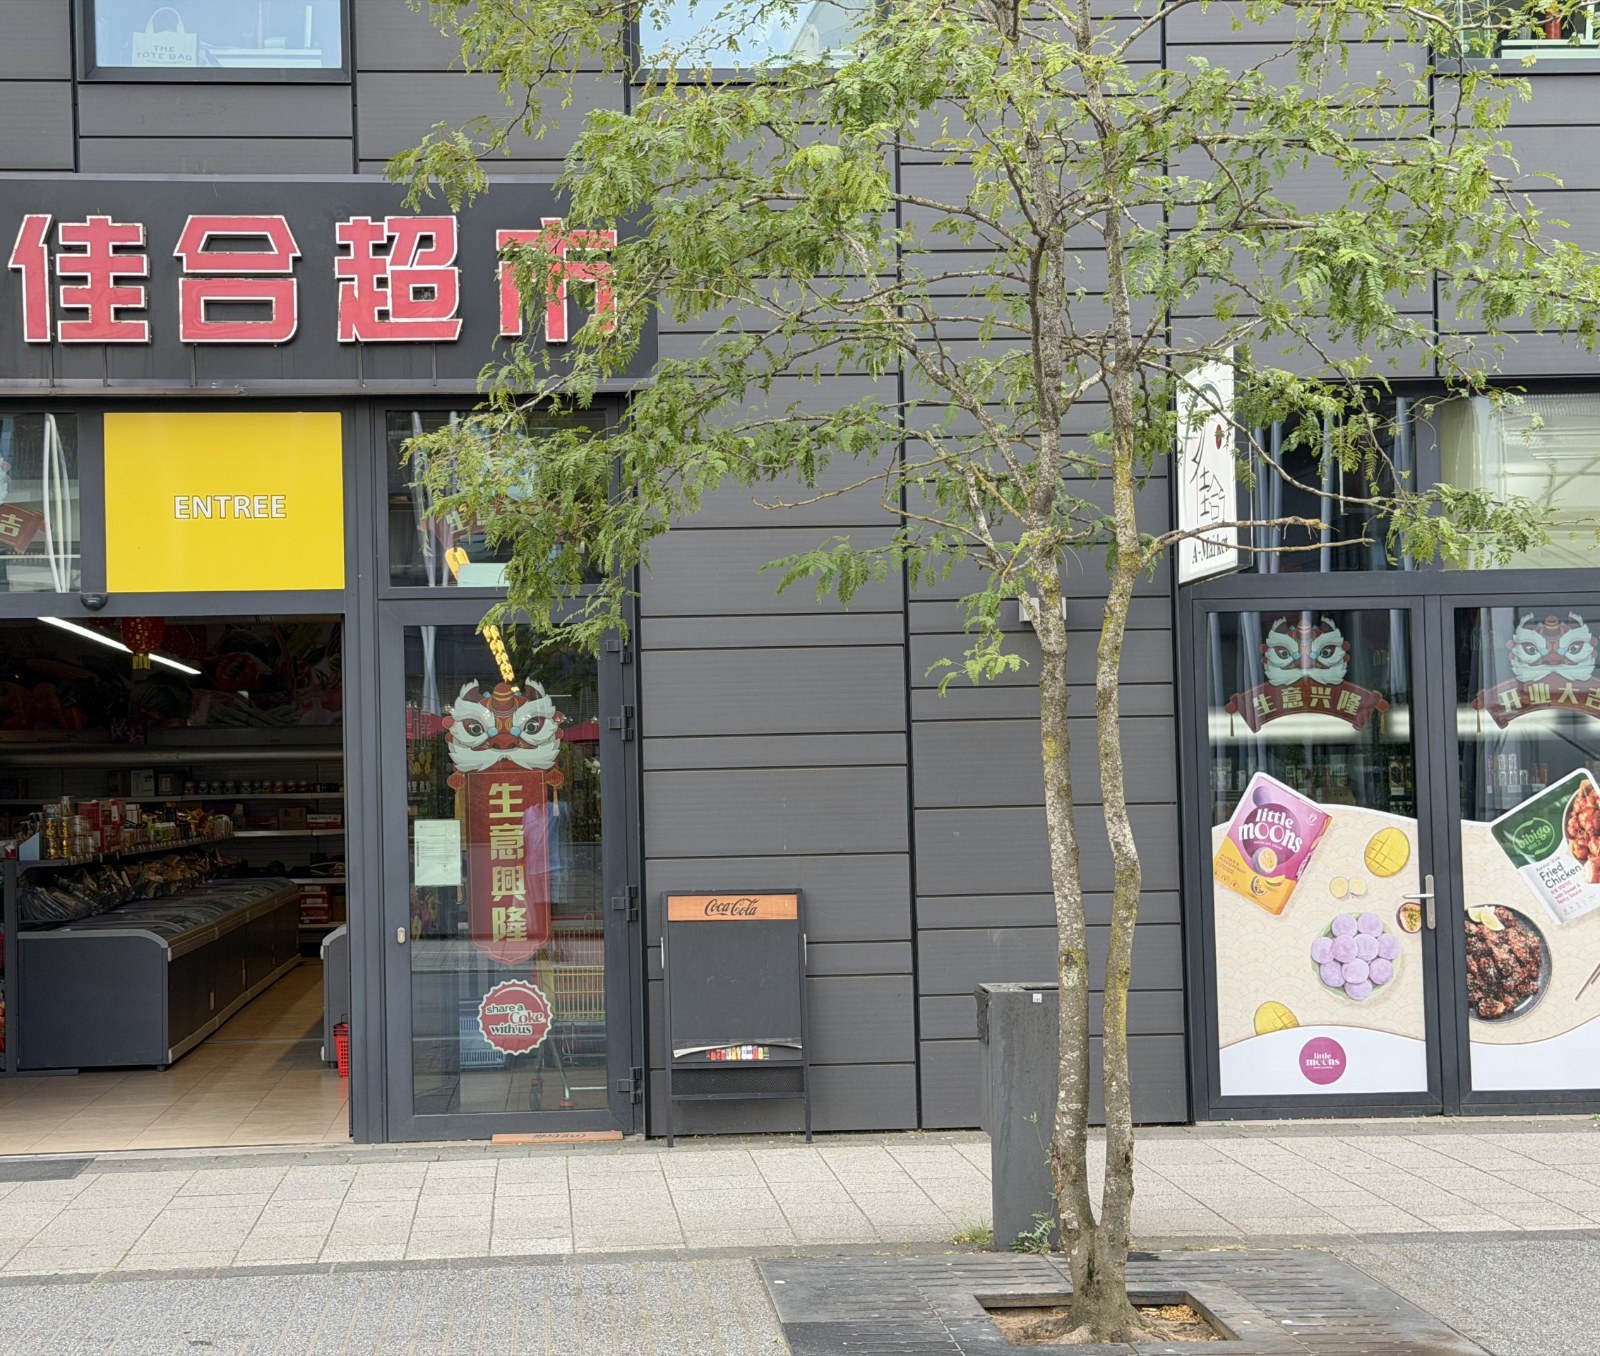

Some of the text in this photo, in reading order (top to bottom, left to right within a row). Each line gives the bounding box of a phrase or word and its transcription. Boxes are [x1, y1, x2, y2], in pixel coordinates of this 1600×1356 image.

[136, 52, 193, 61] TOTE BAG
[154, 45, 176, 53] THE
[8, 213, 617, 343] 佳合超市
[174, 495, 287, 519] ENTREE
[1252, 686, 1362, 717] 生意兴隆
[1255, 808, 1294, 829] little
[1517, 824, 1551, 849] bibigo
[489, 782, 528, 943] 生意興隆
[1539, 863, 1564, 881] Fried
[1545, 865, 1582, 889] Chicken
[704, 898, 760, 916] Coca-Cola
[486, 1004, 524, 1014] share a
[509, 1010, 544, 1024] Coke
[490, 1023, 532, 1034] with us
